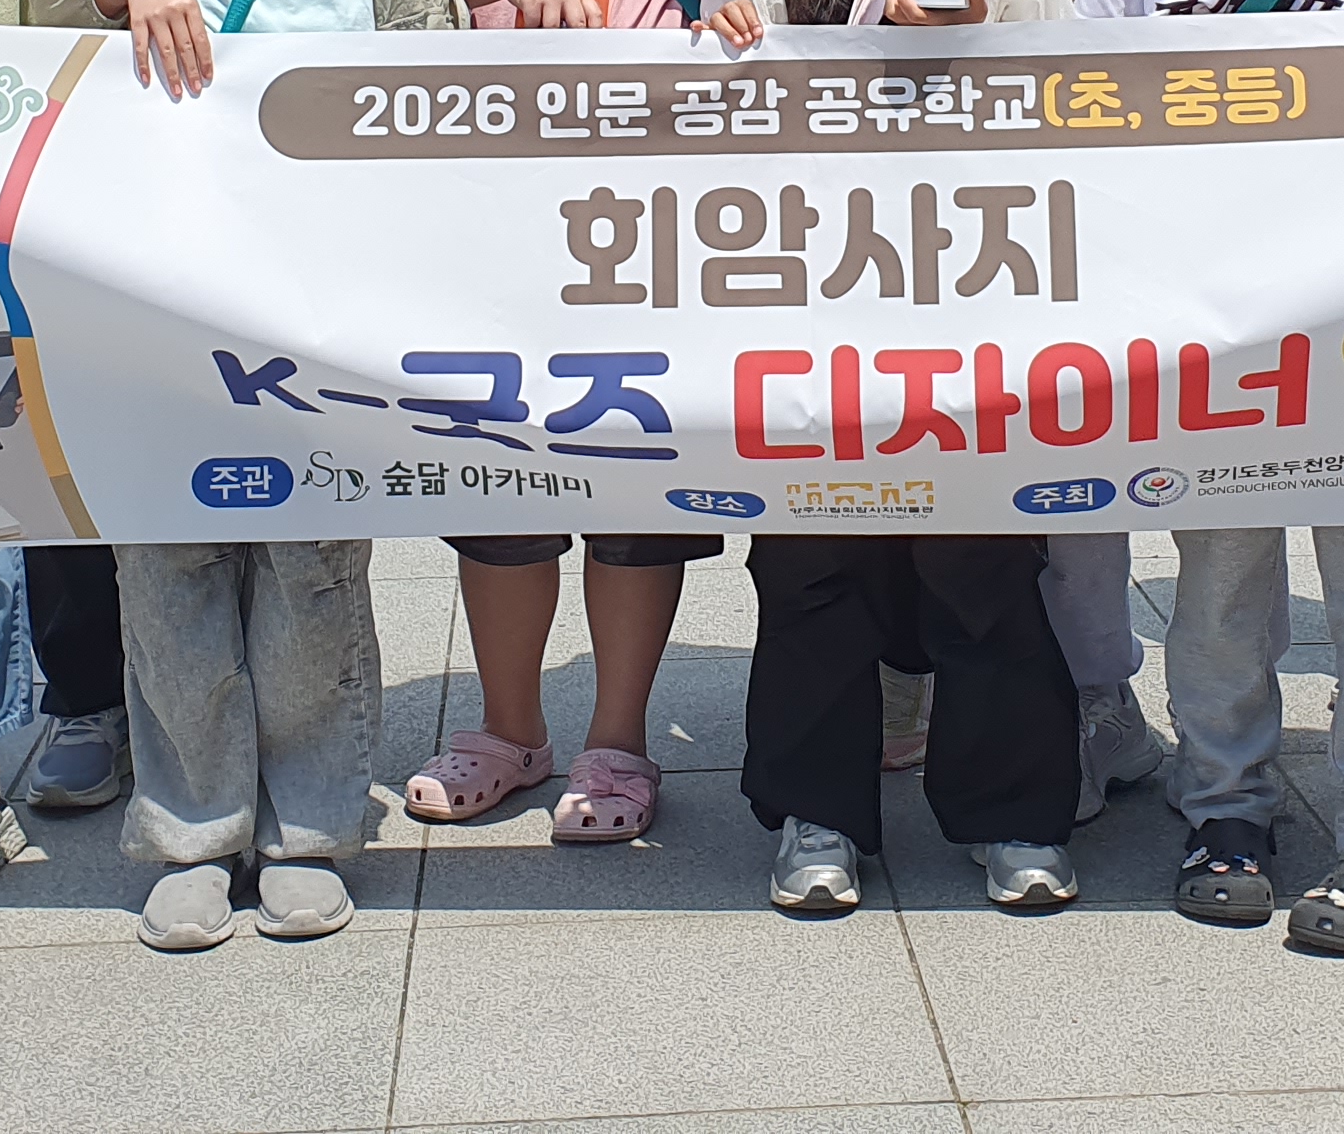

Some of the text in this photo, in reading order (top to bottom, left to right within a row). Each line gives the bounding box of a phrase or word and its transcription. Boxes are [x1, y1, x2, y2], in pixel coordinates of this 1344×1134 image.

[352, 65, 1307, 139] 2026 인문 공감 공유학교(초, 중등)
[559, 178, 1079, 310] 회암사지
[211, 349, 680, 461] K-굿즈
[733, 331, 1311, 461] 디자이너
[208, 464, 274, 501] 주관
[380, 460, 593, 499] 숲닮 아카데미
[1030, 482, 1094, 510] 주최
[1197, 479, 1298, 497] DONGDUCHEON
[684, 491, 748, 514] 장소
